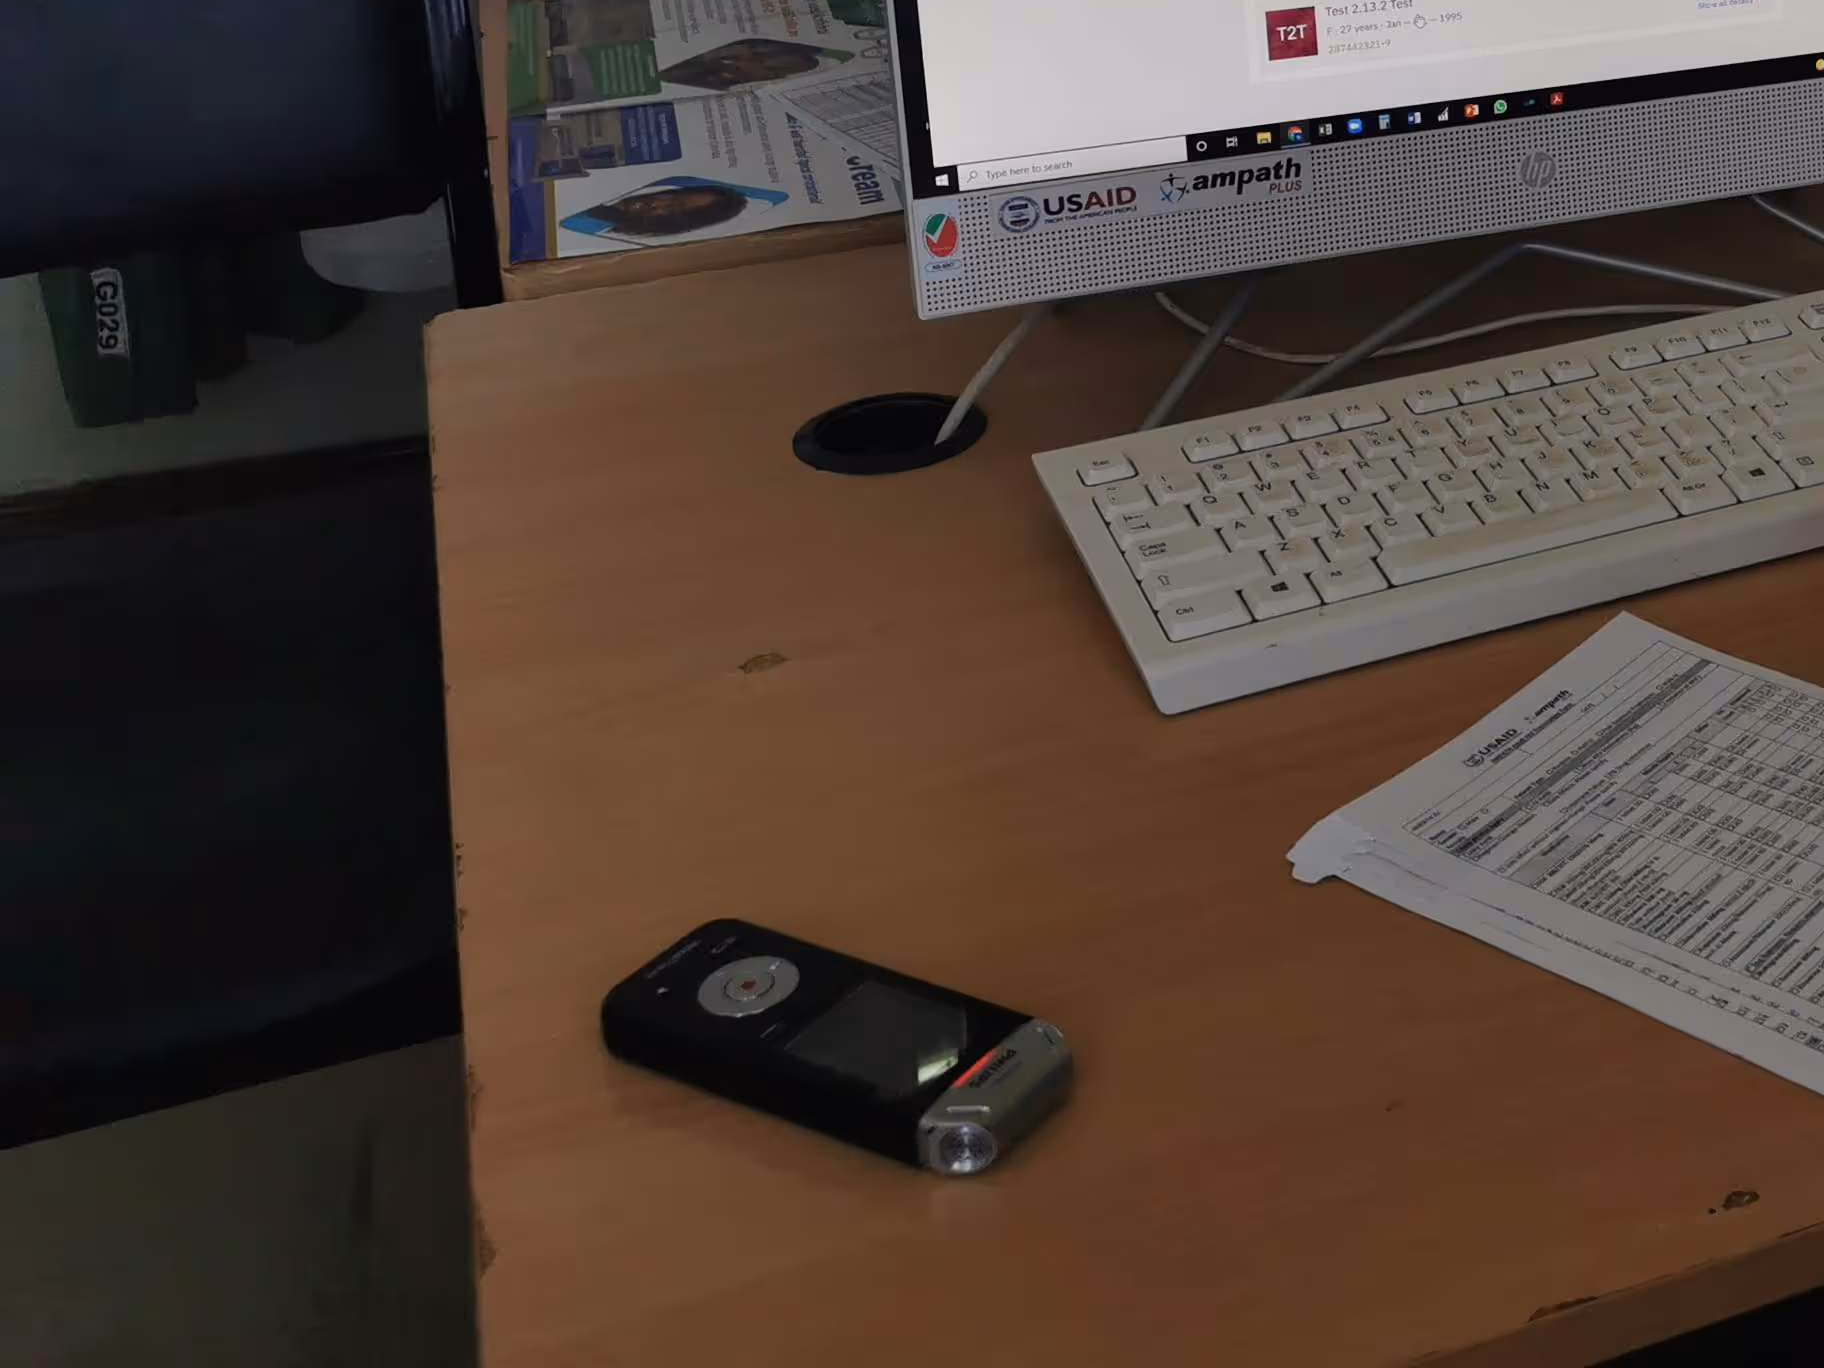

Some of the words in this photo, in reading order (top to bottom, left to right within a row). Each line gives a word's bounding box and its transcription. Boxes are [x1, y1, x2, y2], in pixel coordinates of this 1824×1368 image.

[1325, 5, 1349, 17] Test
[1351, 0, 1388, 14] 2.13.2
[1276, 24, 1308, 41] T2T
[986, 169, 1008, 180] Type
[1009, 167, 1030, 177] here
[1032, 165, 1041, 174] to
[1043, 160, 1073, 172] search
[1191, 157, 1303, 195] ampath
[1523, 151, 1554, 188] hp
[1043, 186, 1137, 216] USAID
[1268, 180, 1303, 195] PLUS
[1534, 689, 1569, 718] ampath
[1478, 728, 1518, 756] USAID
